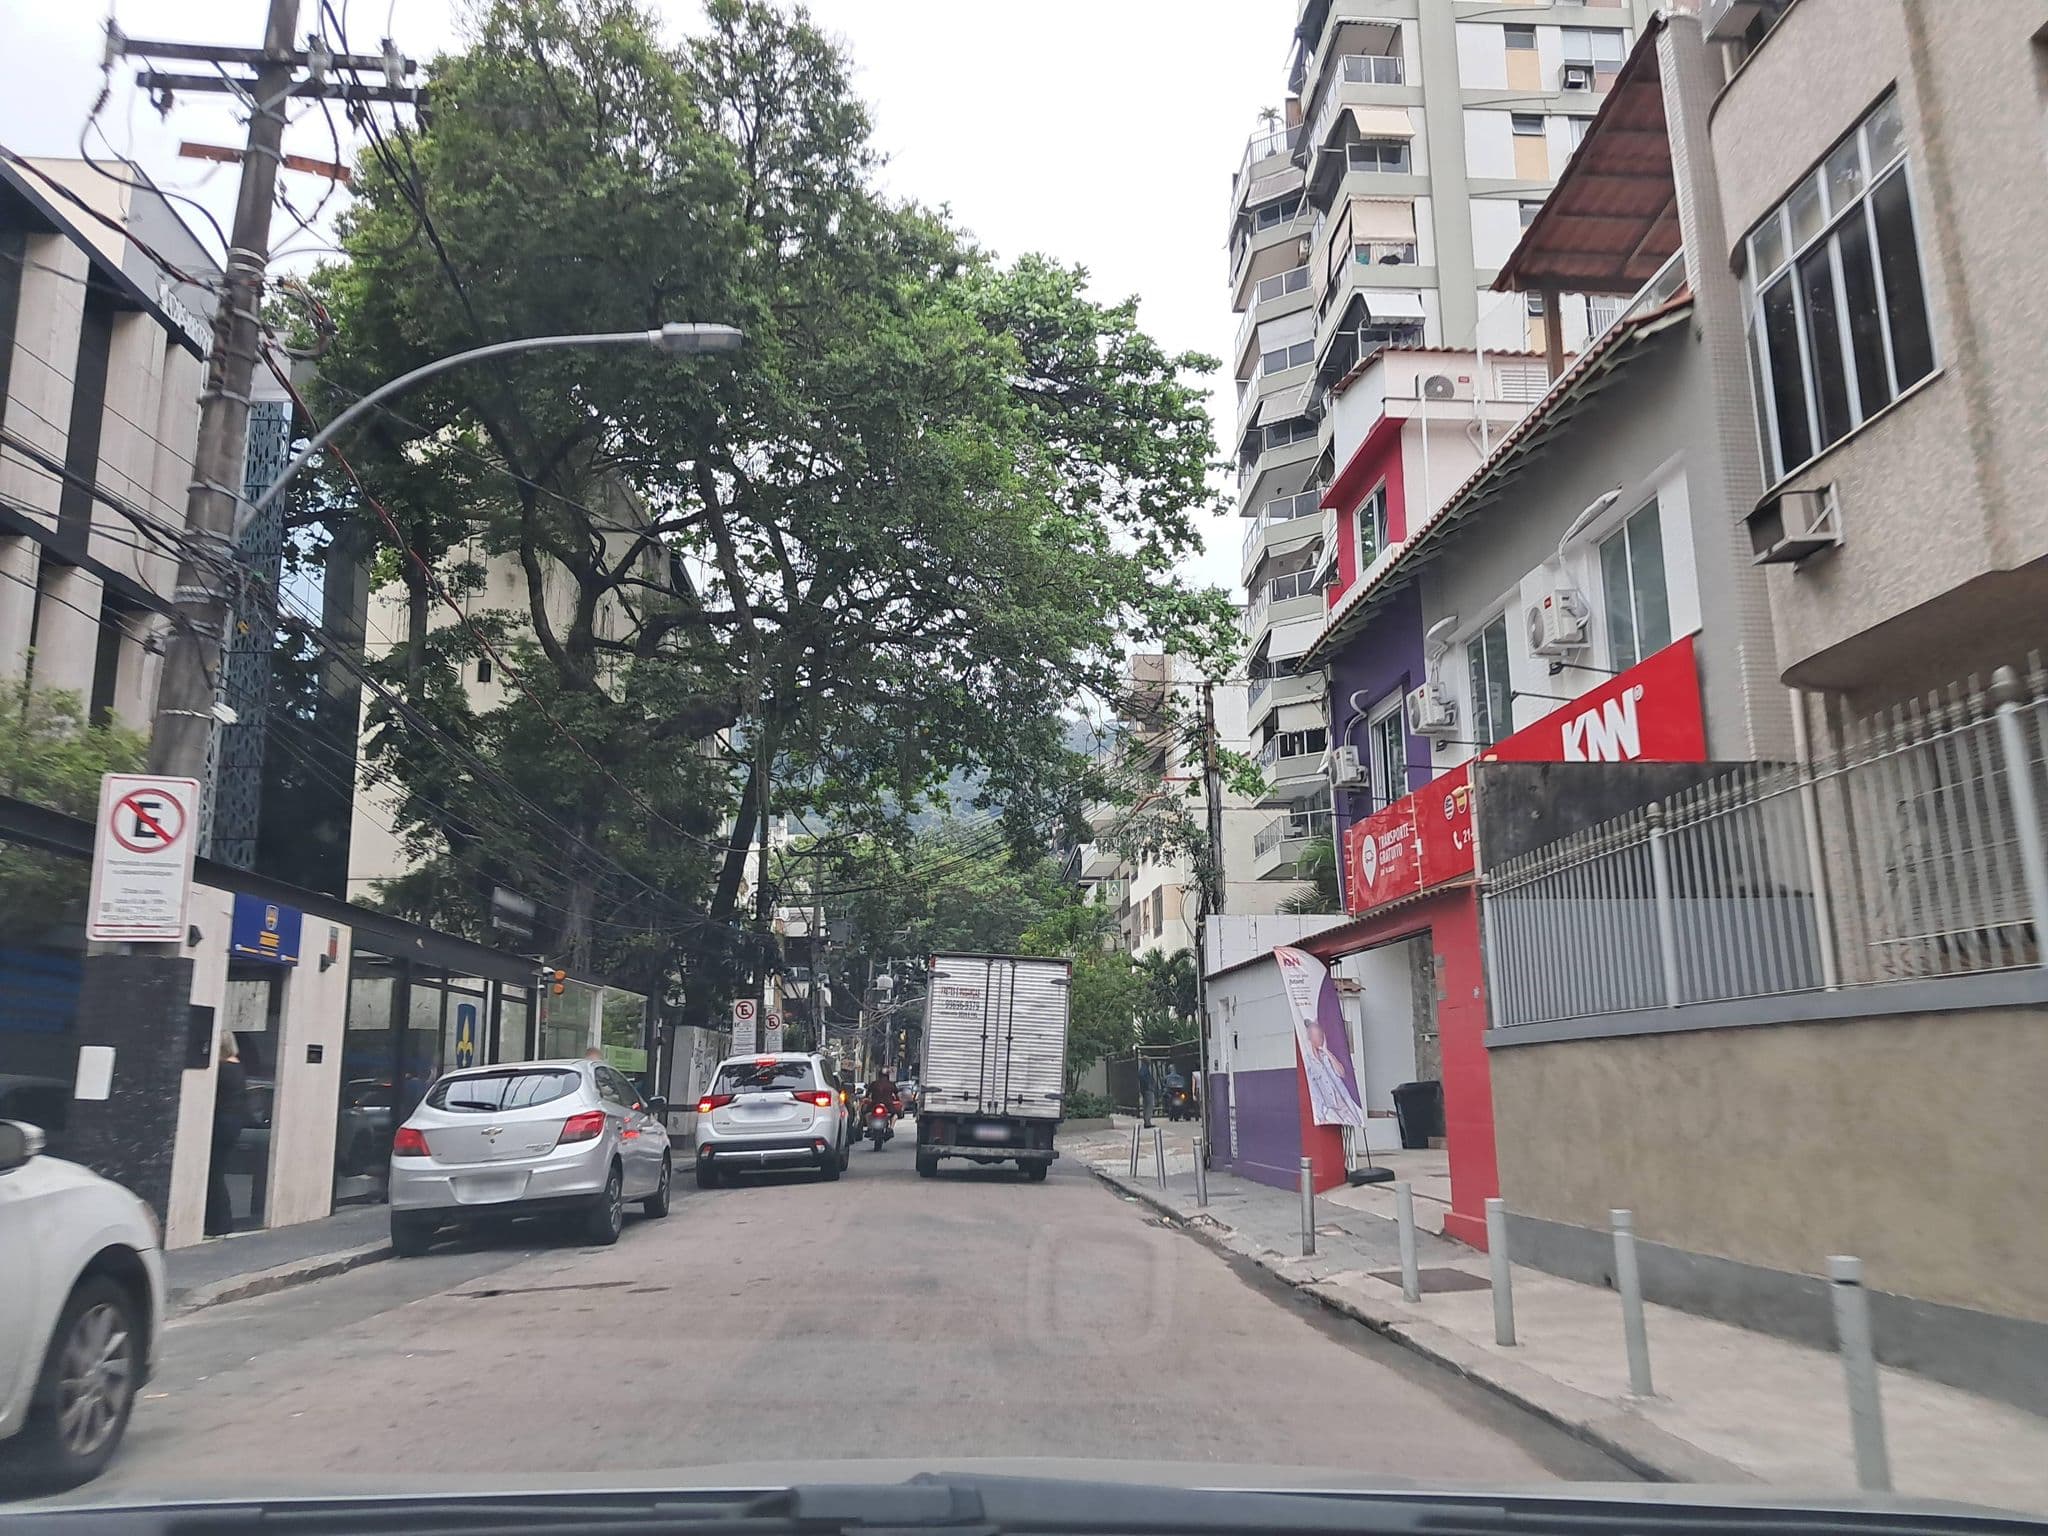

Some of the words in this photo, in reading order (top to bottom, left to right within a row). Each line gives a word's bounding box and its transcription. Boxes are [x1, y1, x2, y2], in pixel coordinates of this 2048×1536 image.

[1561, 687, 1641, 762] KNN
[133, 801, 163, 838] E
[1378, 822, 1410, 850] TRANSPORTE
[1379, 842, 1403, 866] GRATUITO
